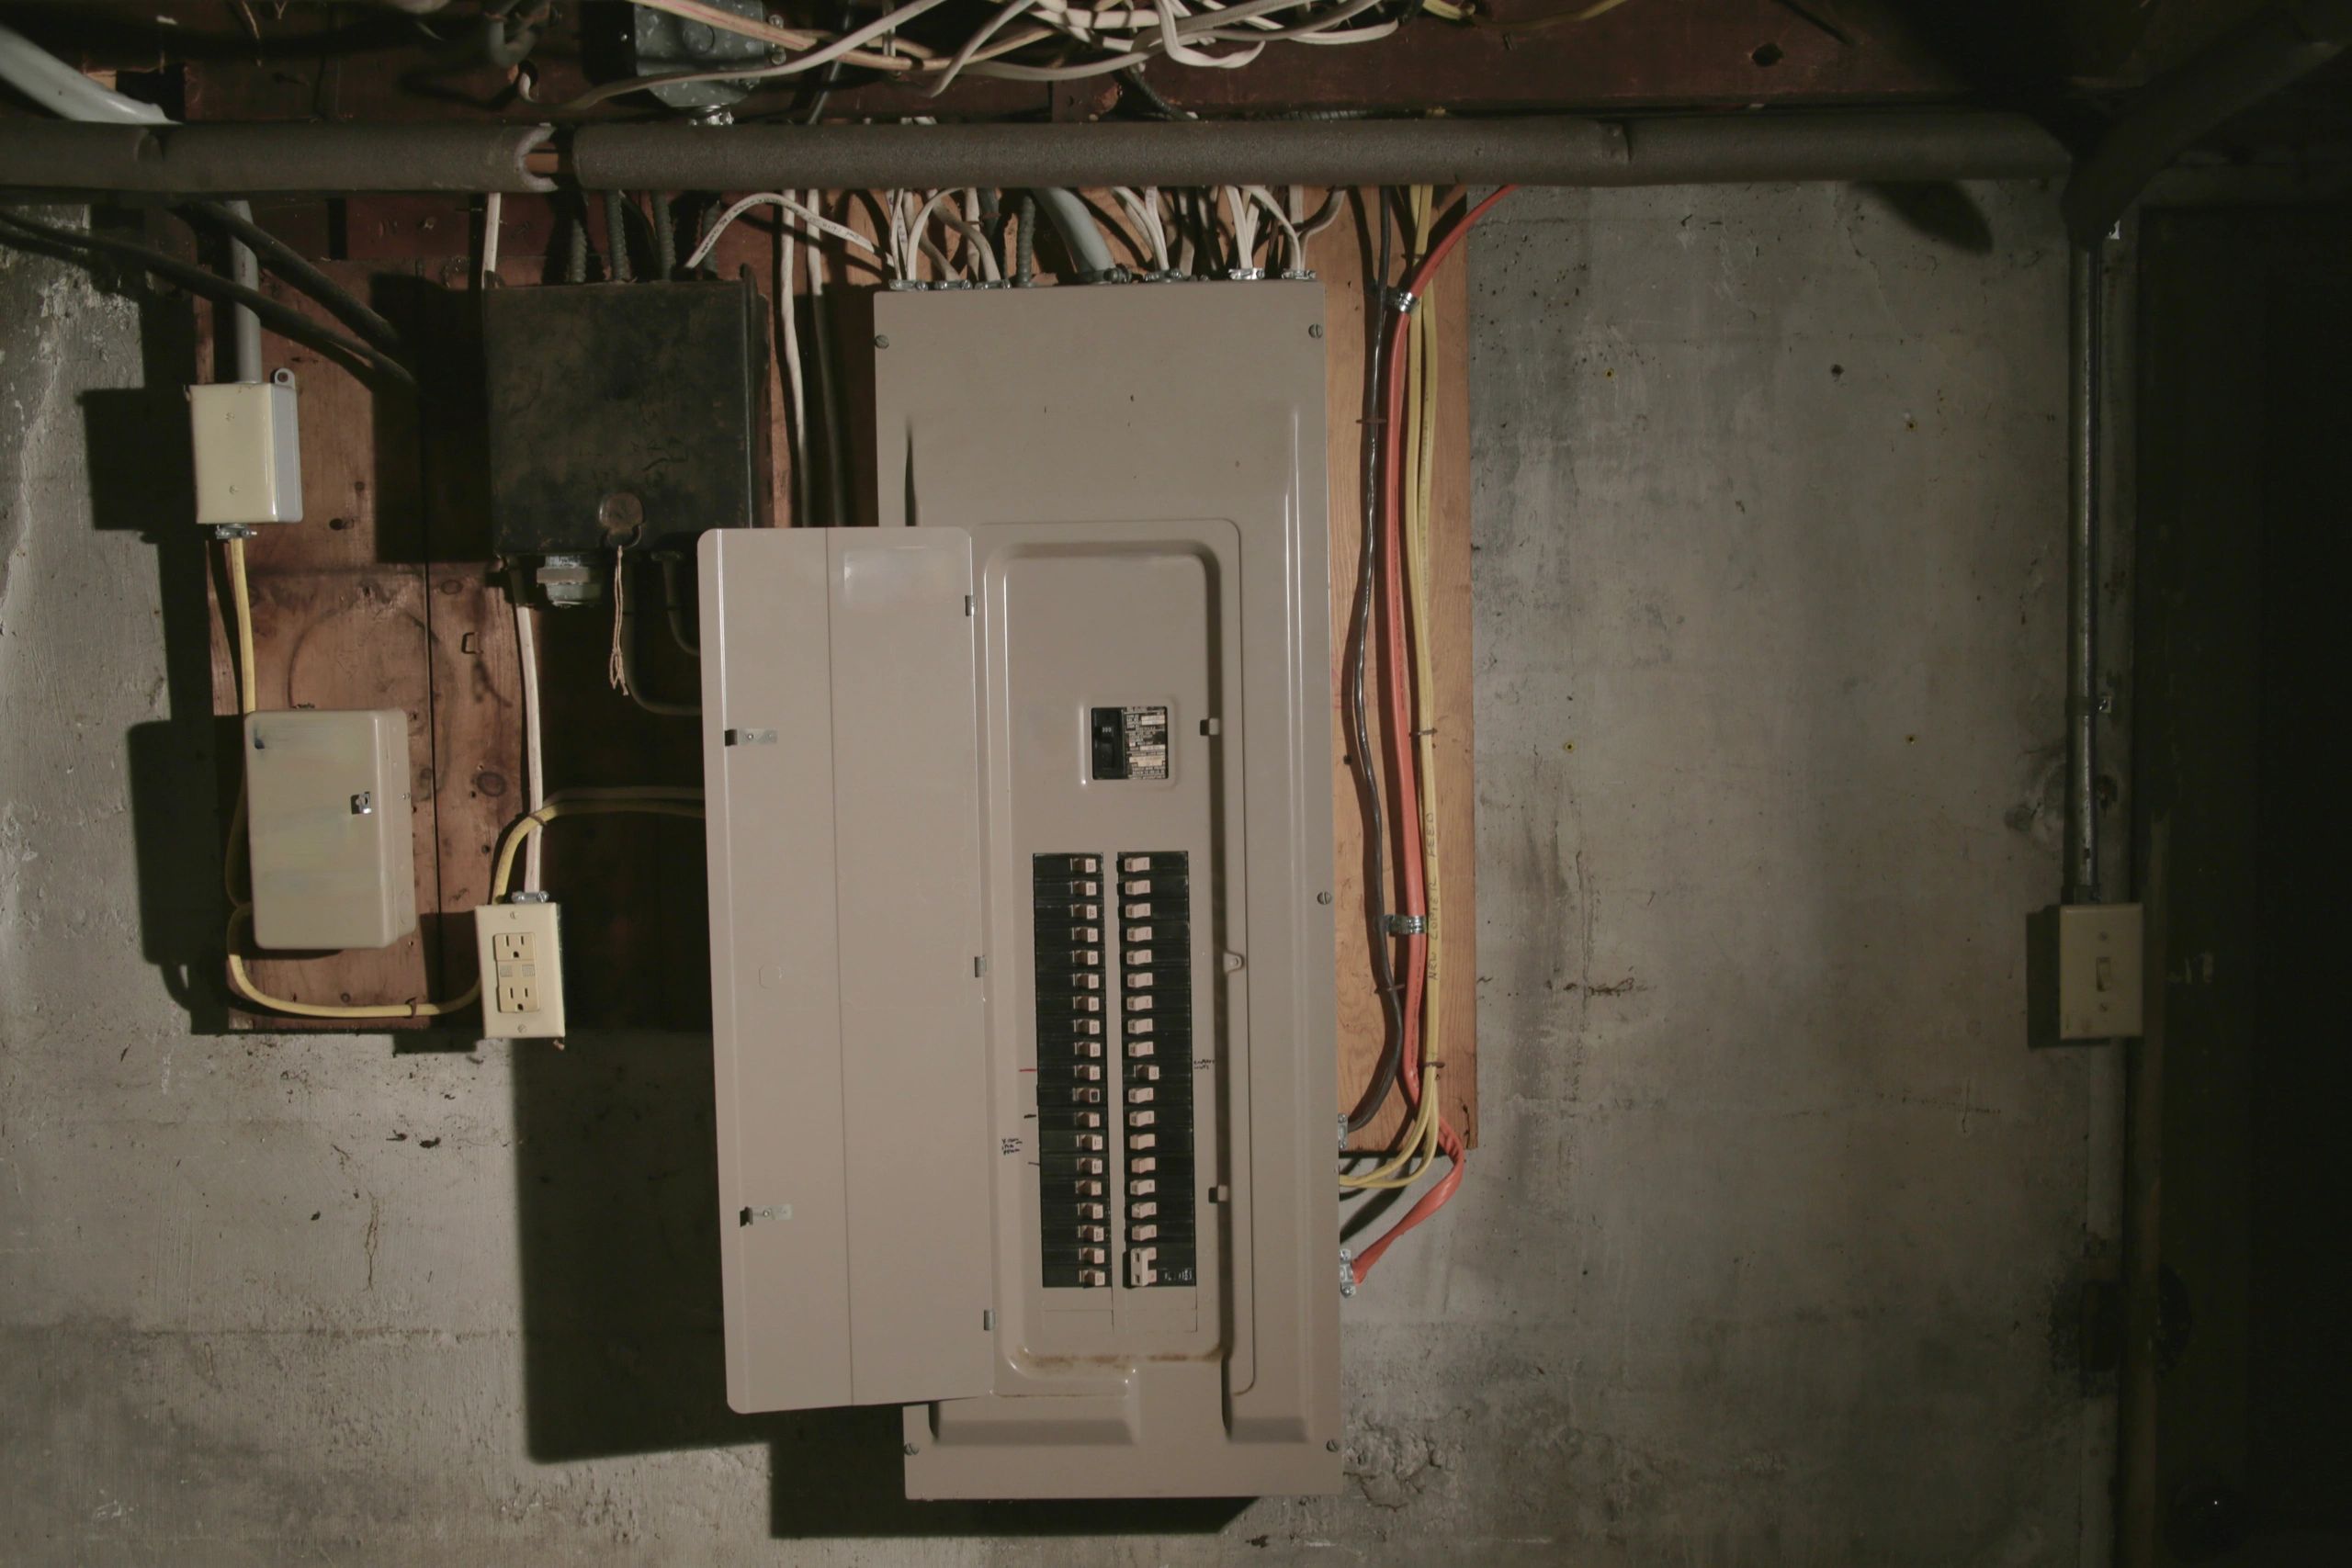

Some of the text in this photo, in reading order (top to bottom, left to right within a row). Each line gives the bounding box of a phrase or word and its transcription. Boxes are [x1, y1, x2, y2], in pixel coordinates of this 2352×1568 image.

[1425, 812, 1439, 981] NEW COPIER FEED
